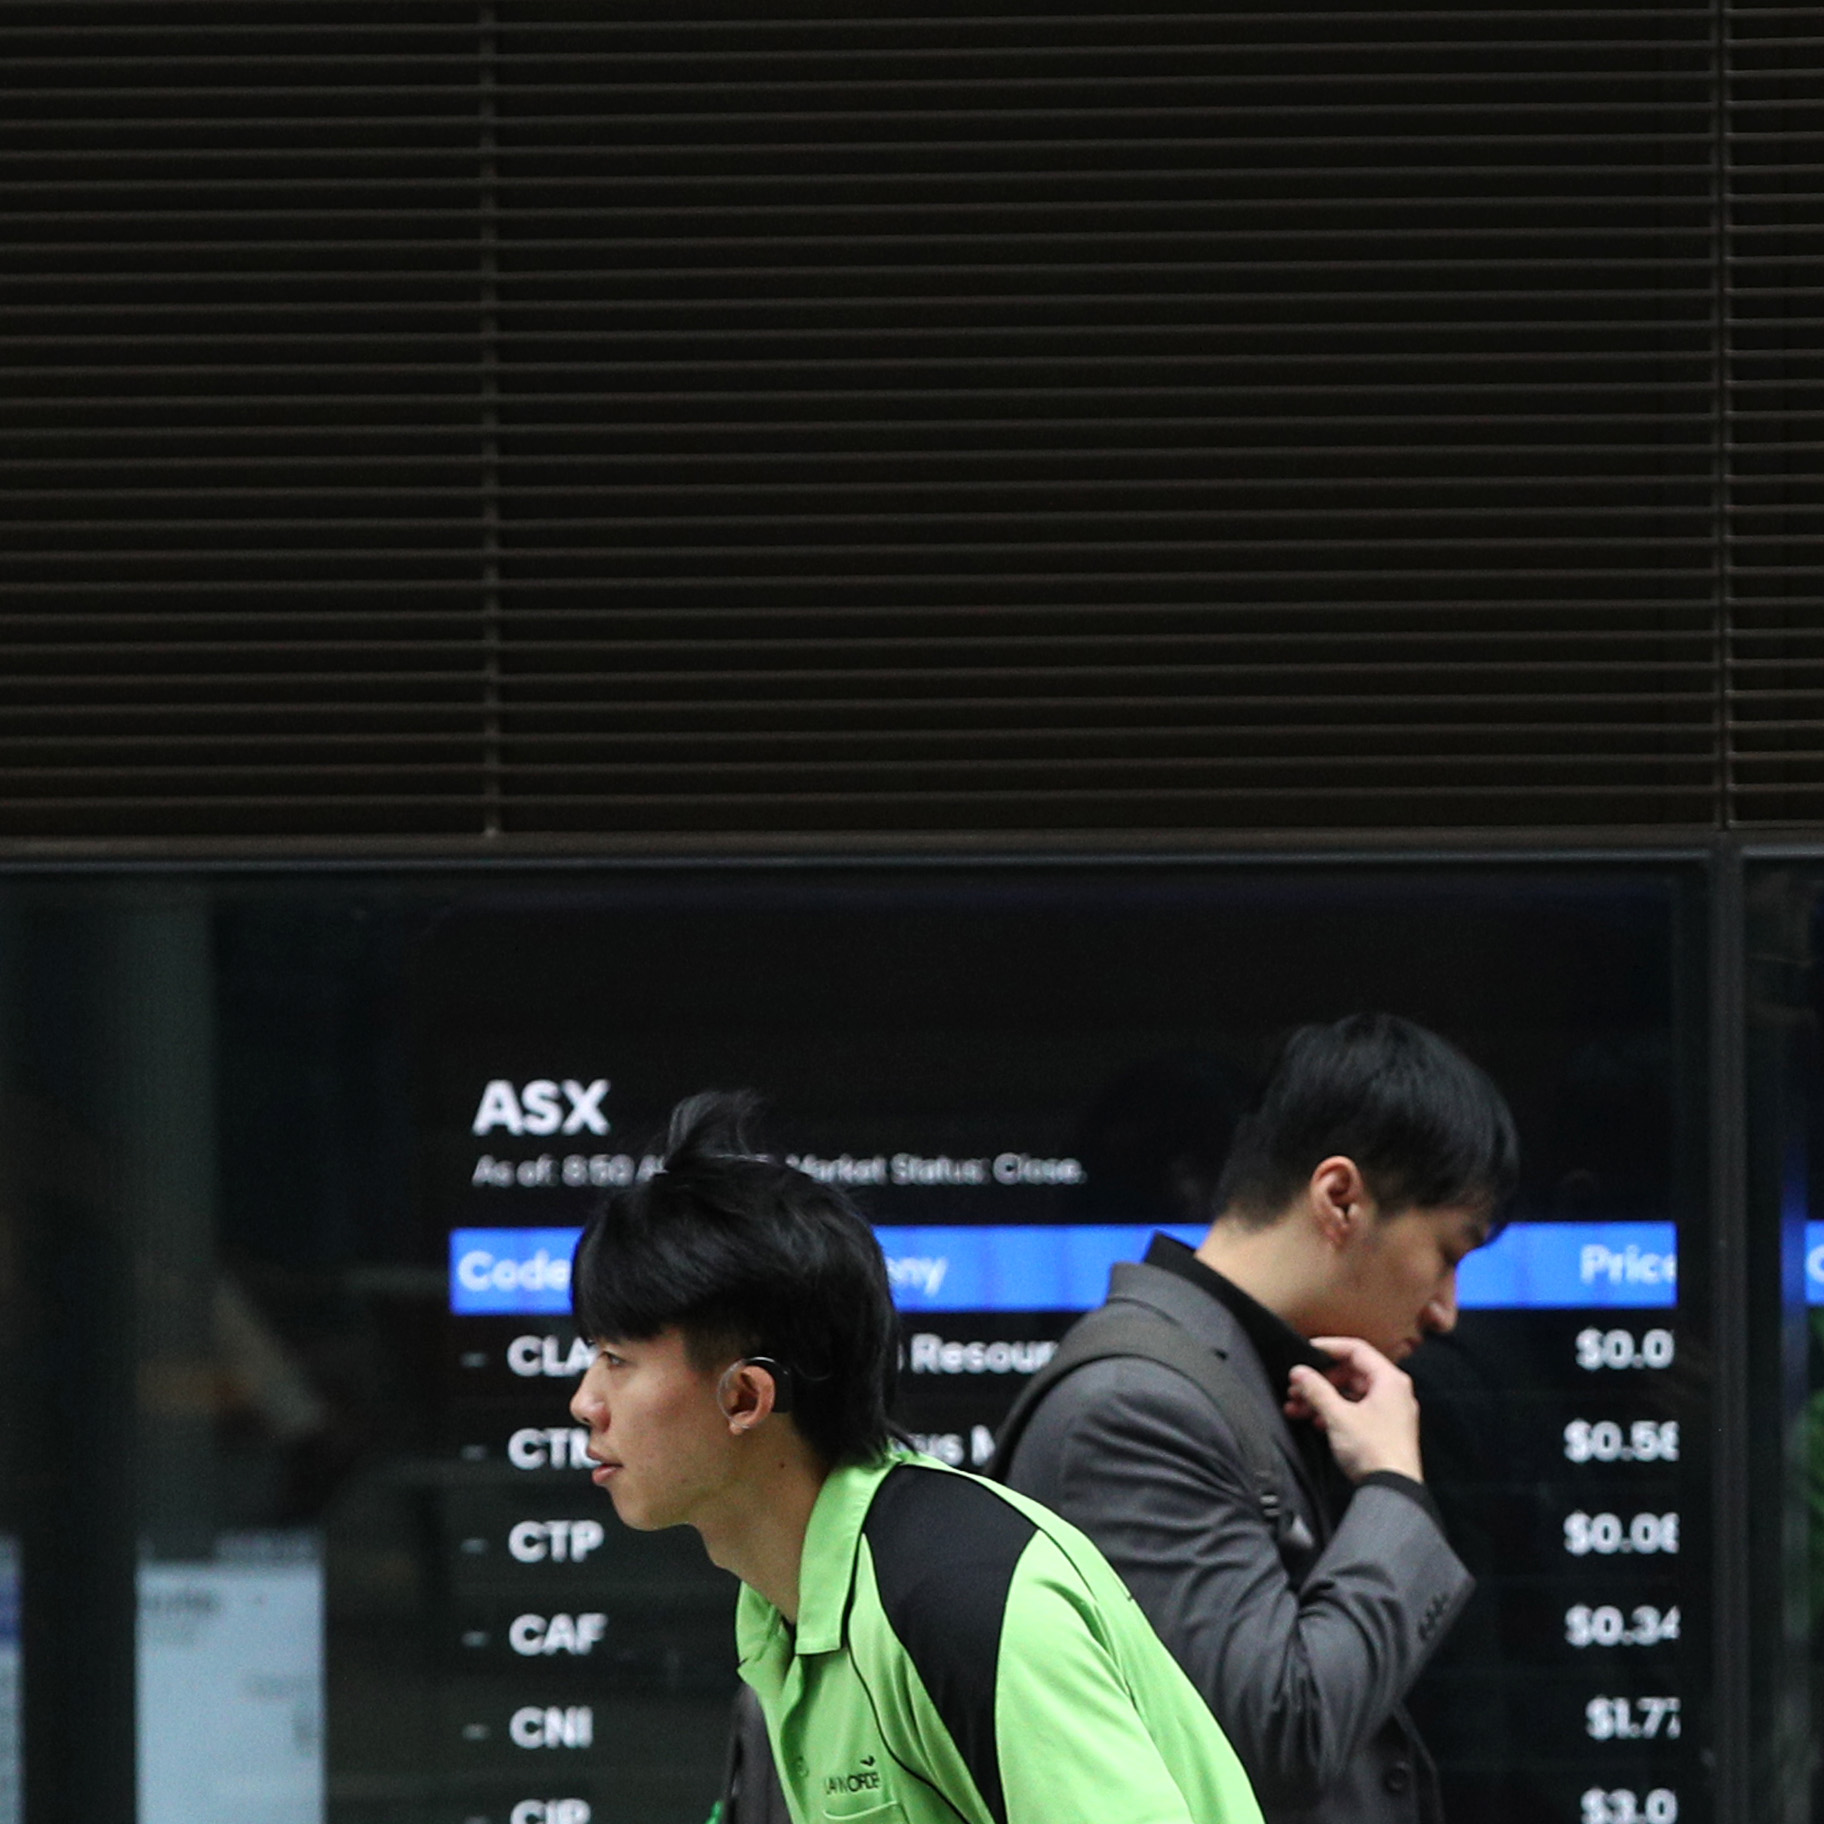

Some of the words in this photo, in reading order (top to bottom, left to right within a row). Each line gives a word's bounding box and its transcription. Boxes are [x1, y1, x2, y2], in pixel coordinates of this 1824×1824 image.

[473, 1080, 610, 1135] ASX
[509, 1519, 605, 1564] CTP
[509, 1613, 609, 1657] CAF
[509, 1706, 594, 1749] CNI
